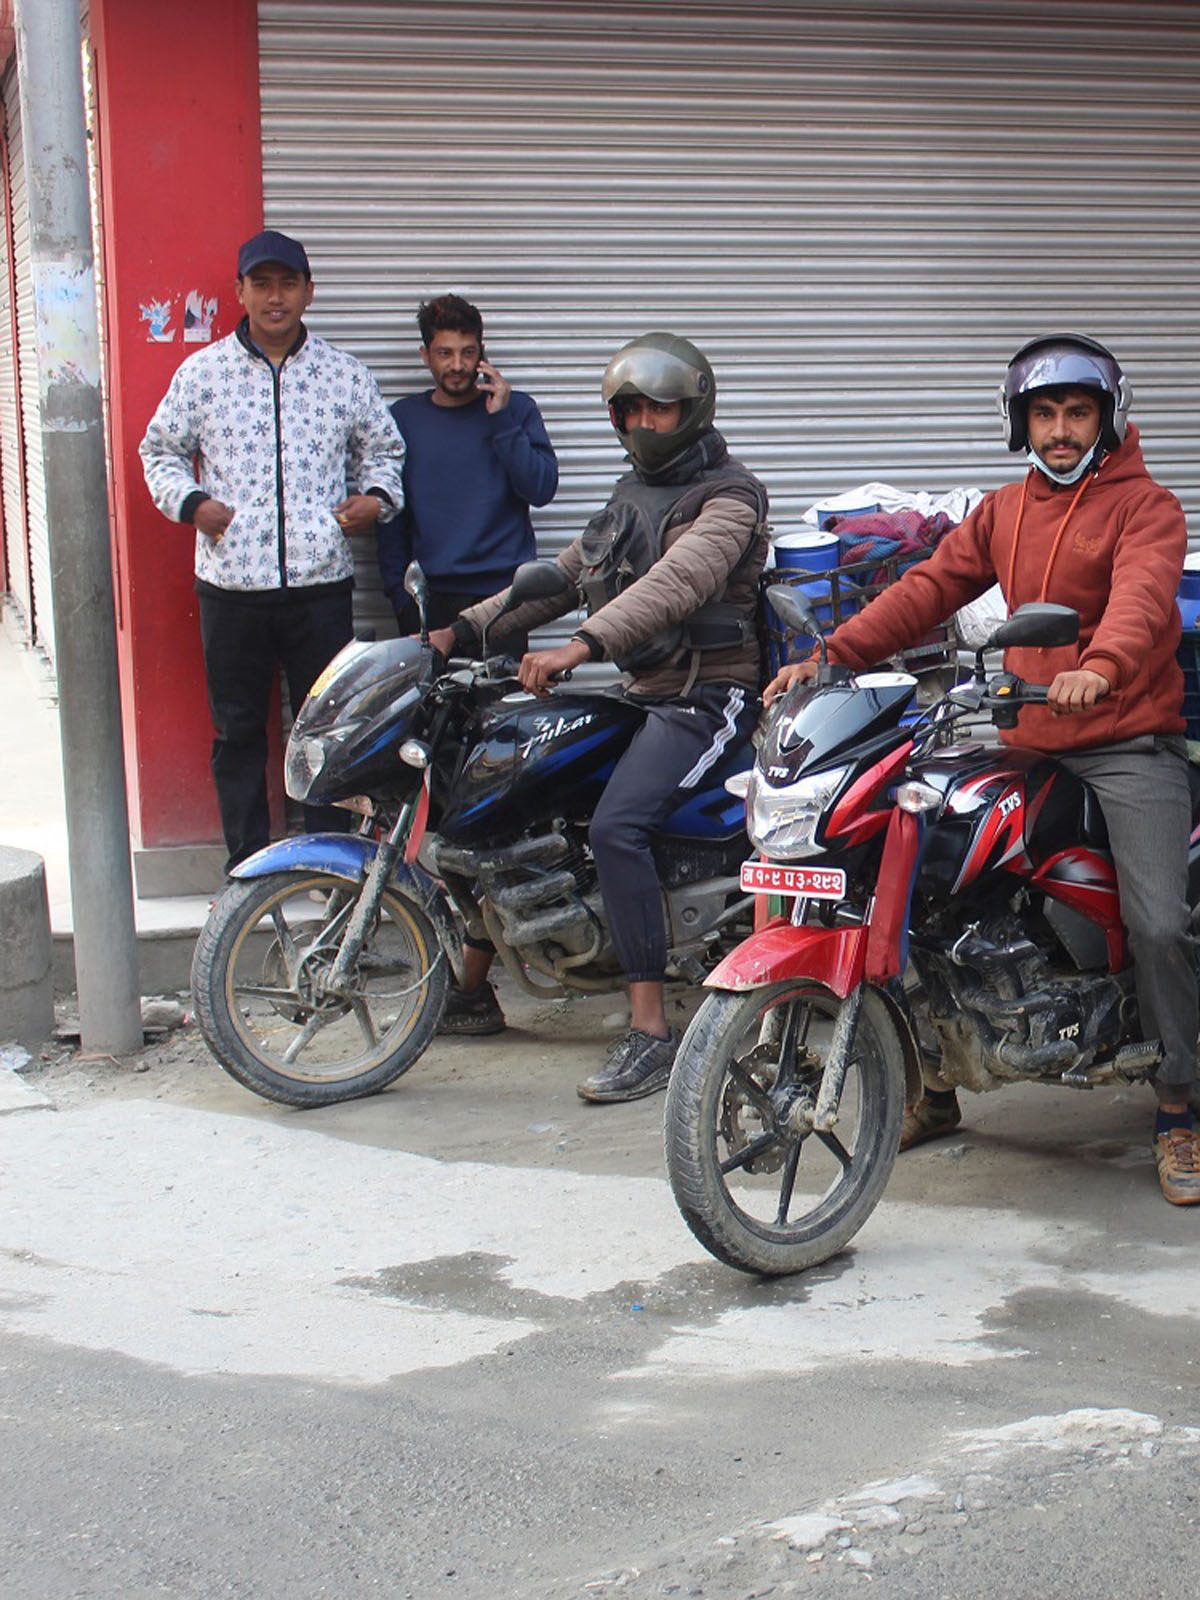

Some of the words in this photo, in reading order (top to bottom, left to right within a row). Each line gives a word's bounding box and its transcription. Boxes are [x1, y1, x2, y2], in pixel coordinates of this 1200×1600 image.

[768, 766, 790, 778] TVS
[998, 791, 1021, 817] TVS
[1059, 1022, 1079, 1040] TVS
